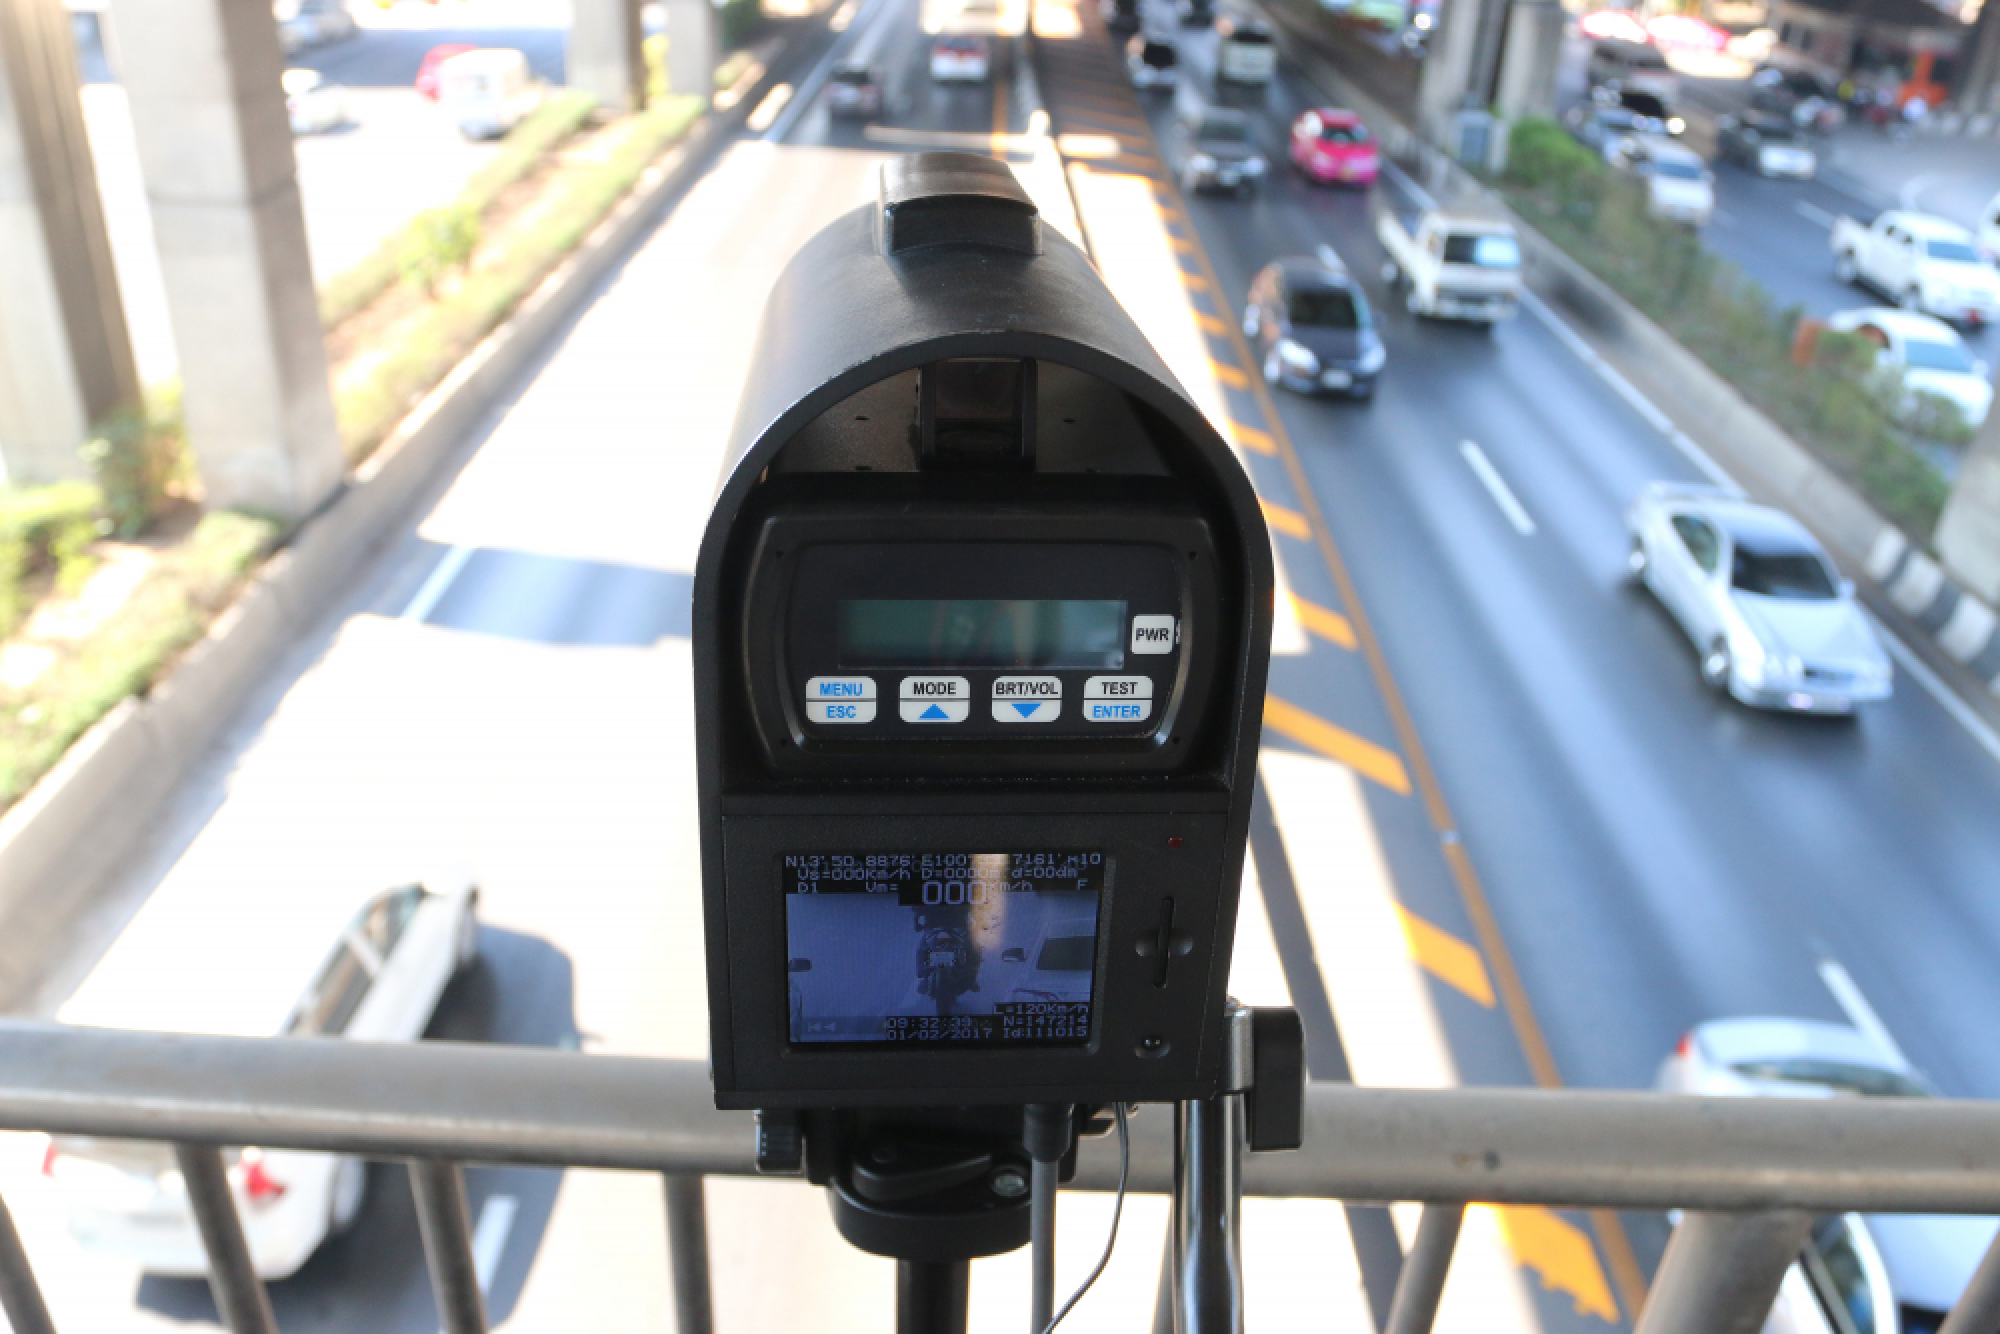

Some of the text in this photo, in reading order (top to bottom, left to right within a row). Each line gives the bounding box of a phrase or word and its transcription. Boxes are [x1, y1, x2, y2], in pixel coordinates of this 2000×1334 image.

[1136, 628, 1170, 642] PWR
[819, 683, 863, 697] MENU
[913, 682, 957, 695] MODE
[995, 682, 1059, 696] BRT/VOL
[1101, 682, 1138, 695] TEST
[826, 706, 857, 719] ESC
[1093, 705, 1141, 718] ENTER
[887, 1028, 993, 1040] 01/02/2017
